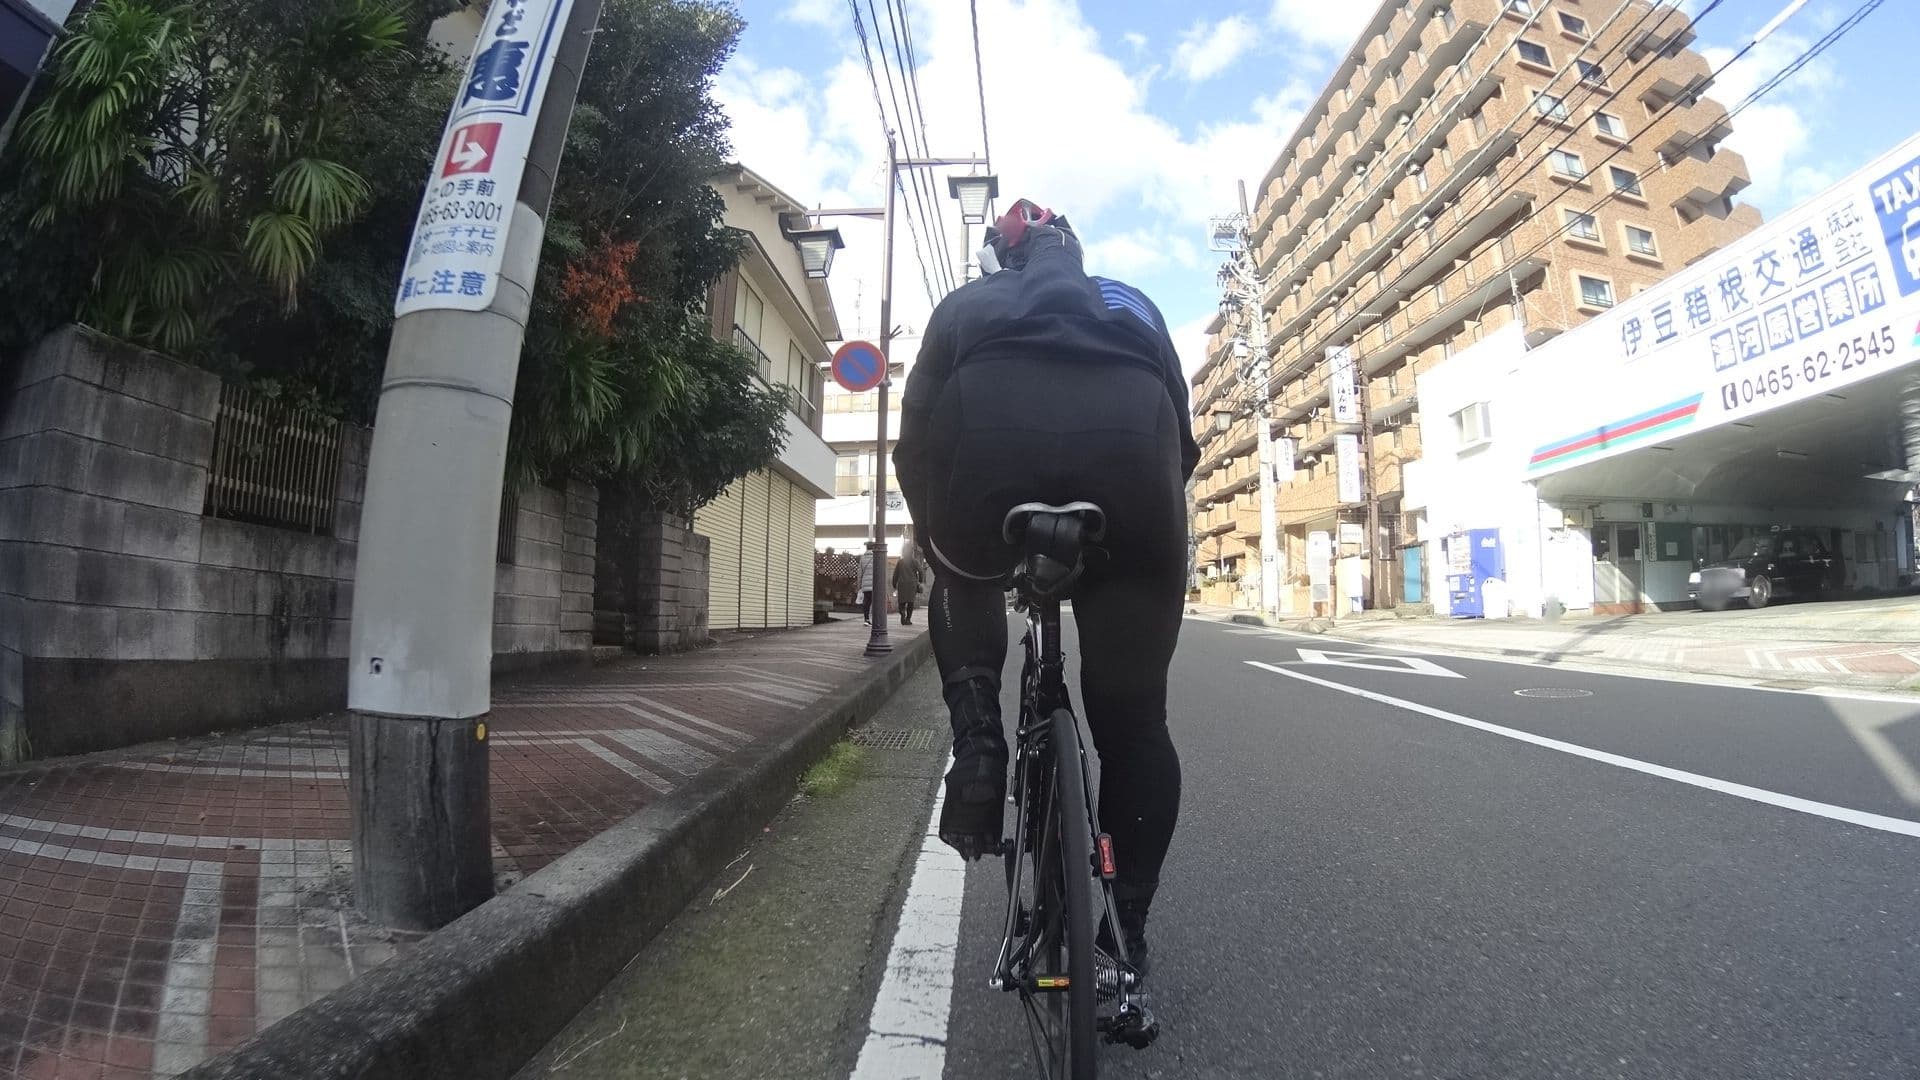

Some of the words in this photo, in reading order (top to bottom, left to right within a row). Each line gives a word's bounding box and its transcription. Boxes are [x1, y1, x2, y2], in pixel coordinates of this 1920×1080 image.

[1827, 200, 1864, 236] 株式
[1834, 231, 1869, 264] 会社
[1621, 226, 1825, 358] 伊豆箱根交通
[1710, 262, 1885, 372] 湯河原営業所
